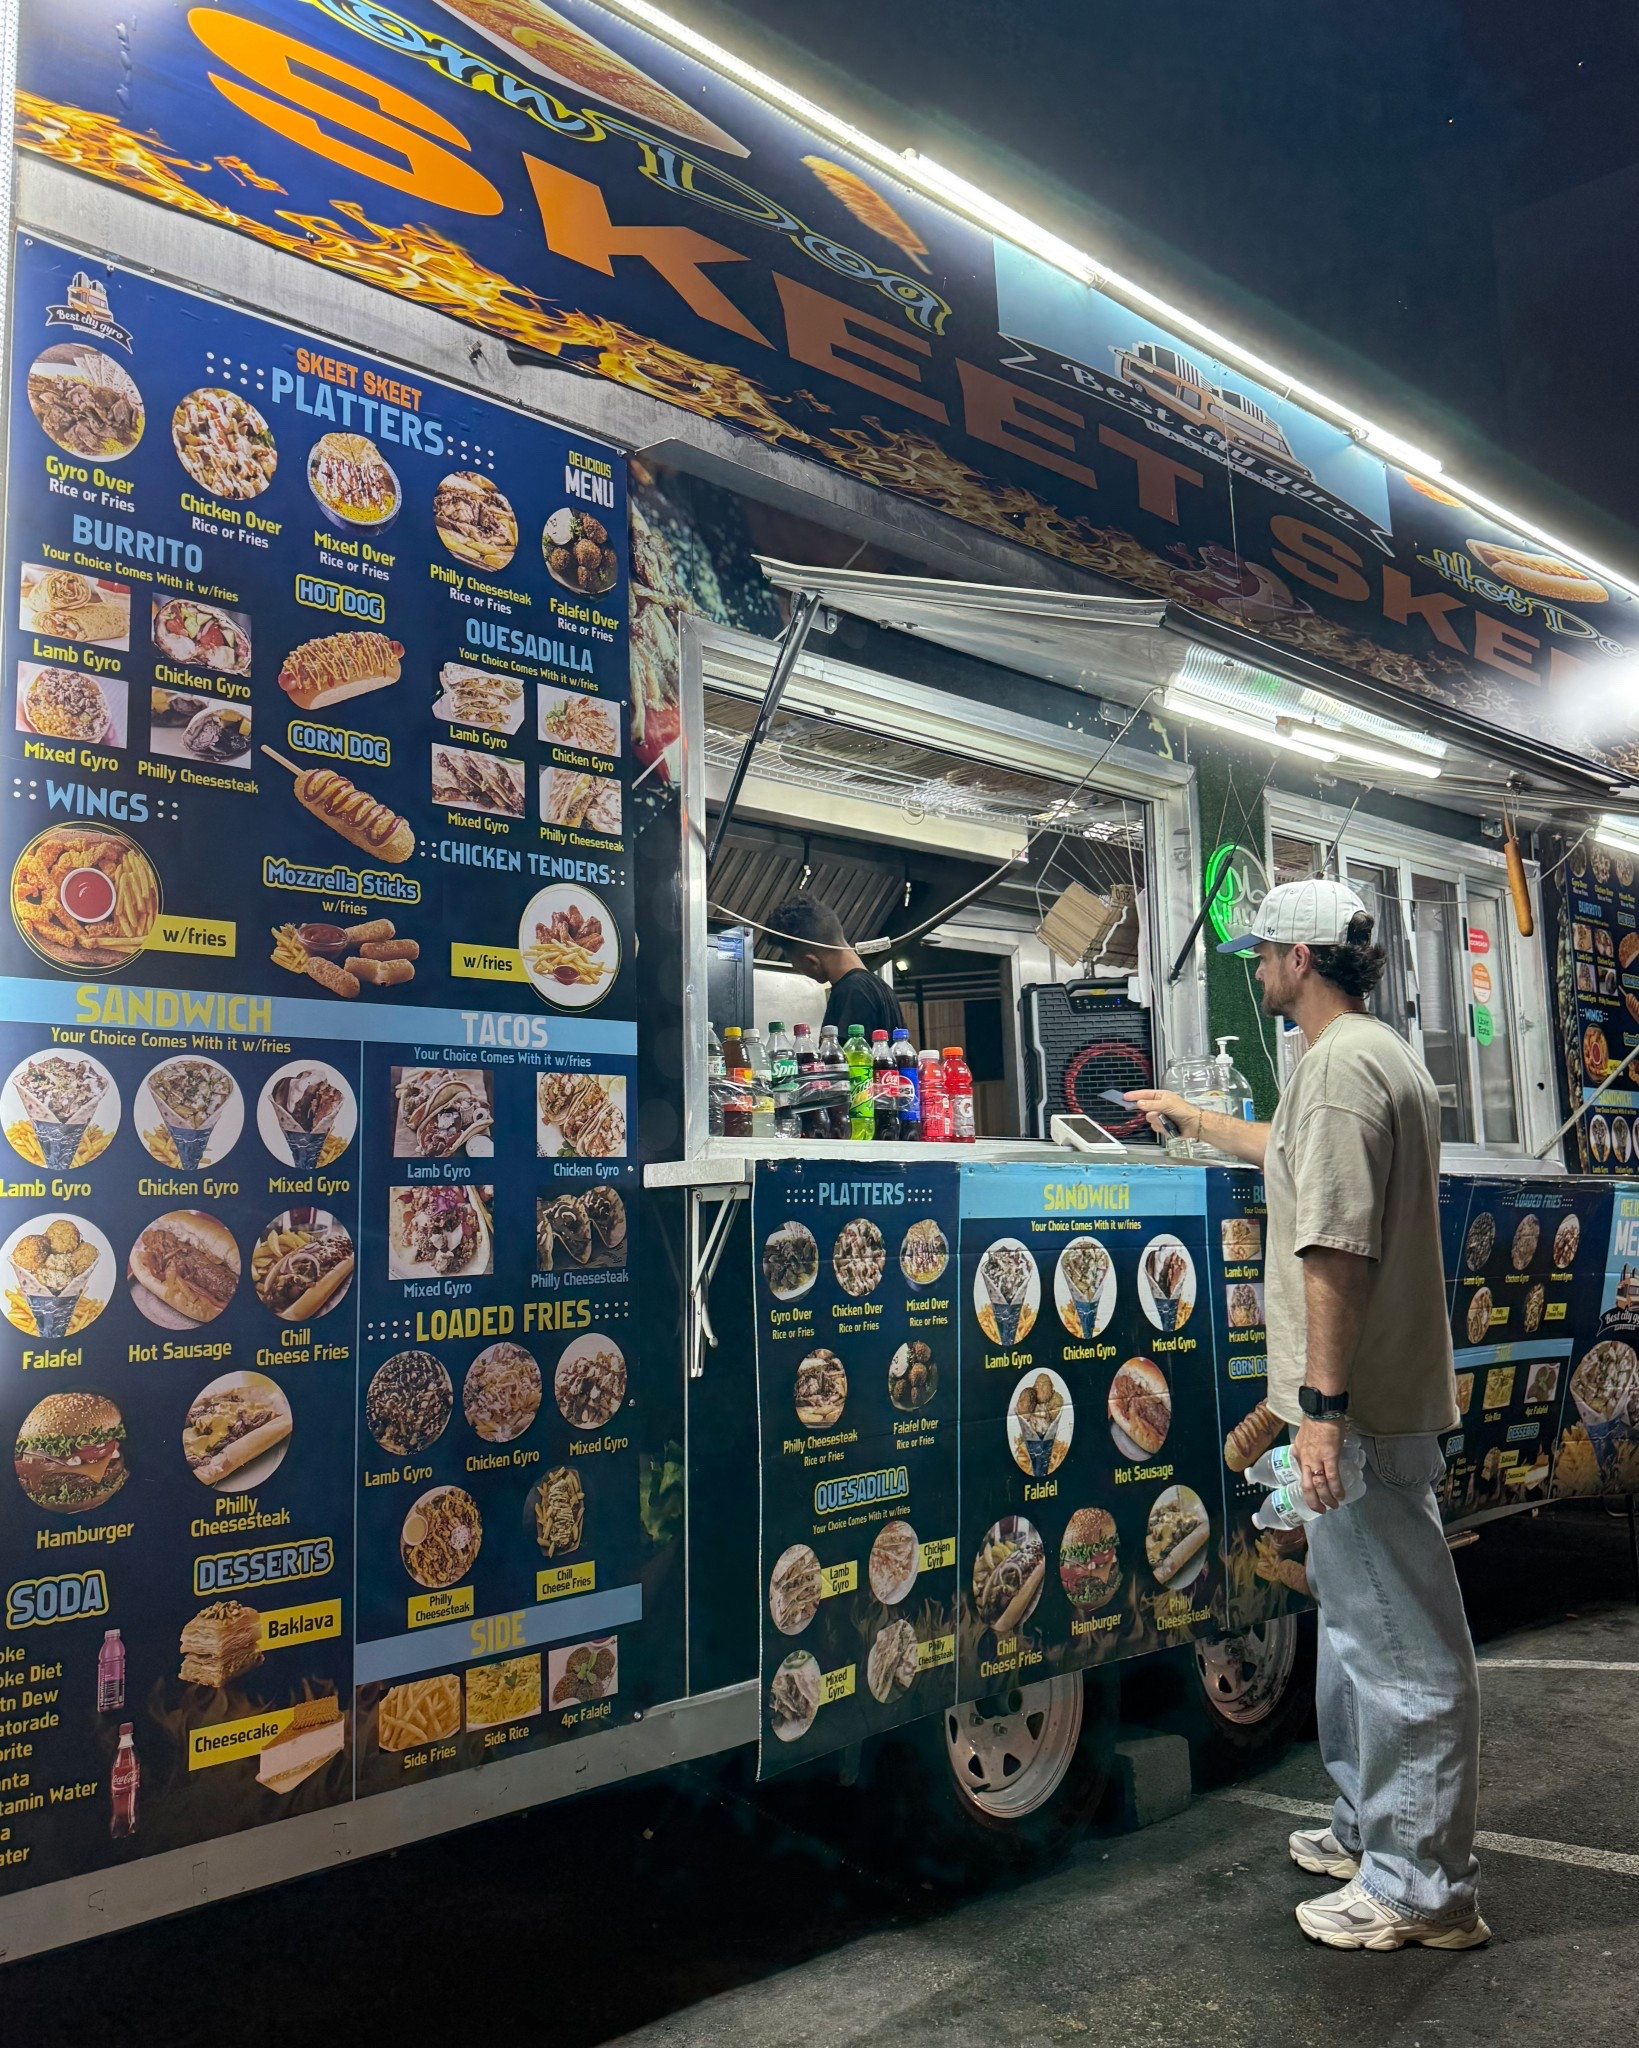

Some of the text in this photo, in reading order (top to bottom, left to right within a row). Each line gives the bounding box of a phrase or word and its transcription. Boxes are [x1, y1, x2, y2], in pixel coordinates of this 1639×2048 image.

[581, 108, 952, 336] Dog
[187, 8, 1203, 526] SKEET
[56, 309, 80, 322] Best
[81, 314, 98, 329] city
[100, 323, 124, 339] gyro
[297, 348, 422, 411] SKEET SKEET
[271, 367, 444, 456] PLATTERS
[1061, 363, 1359, 523] Best city gyro
[46, 455, 134, 494] Gyro Over
[568, 451, 612, 479] DELICIOUS
[49, 479, 135, 513] Rice or Fries
[565, 466, 614, 509] MENU
[180, 493, 282, 535] Chicken Over
[73, 513, 202, 573] BURRITO
[42, 543, 239, 603] Your Choice Comes With it w/fries
[429, 563, 532, 606] Philly Cheesesteak
[1417, 549, 1533, 617] Hot
[298, 576, 382, 620] HOT DOG
[466, 617, 594, 674] QUESADILLA
[155, 664, 251, 698] Chicken Gyro
[291, 725, 387, 762] CORN DOG
[552, 748, 615, 773] Chicken Gyro
[138, 760, 259, 794] Philly Cheesesteak
[46, 780, 149, 822] WINGS
[440, 840, 610, 885] CHICKEN TENDERS
[267, 861, 417, 900] Mozzrella Sticks
[1578, 901, 1602, 917] BURRITO
[162, 926, 227, 947] w/fries
[75, 985, 272, 1033] SANDWICH
[461, 1012, 549, 1048] TACOS
[413, 1047, 592, 1068] Your Choice Comes With it w/fries
[772, 1062, 798, 1077] Spri
[553, 1163, 620, 1179] Chicken Gyro
[0, 1178, 92, 1201] Lamb Gyro
[818, 1182, 905, 1206] PLATTERS
[1043, 1183, 1130, 1211] SANDWICH
[1514, 1193, 1563, 1208] LOADED FRIES
[1031, 1219, 1142, 1232] Your Choice Comes With it w/fries
[1614, 1219, 1639, 1257] ME
[1225, 1266, 1259, 1280] Lamb Gyro
[415, 1299, 592, 1342] LOADED FRIES
[770, 1309, 813, 1325] Gyro Over
[832, 1303, 884, 1318] Chicken Over
[1605, 1313, 1620, 1324] Best
[280, 1328, 311, 1347] Chill
[838, 1321, 880, 1334] Rice or Fries
[128, 1341, 233, 1363] Hot Sausage
[256, 1343, 350, 1367] Cheese Fries
[1152, 1337, 1197, 1353] Mixed Gyro
[22, 1348, 82, 1370] Falafel
[985, 1353, 1033, 1370] Lamb Gyro
[1231, 1358, 1268, 1376] CORN DO
[893, 1418, 939, 1435] Falafel Over
[569, 1436, 629, 1456] Mixed Gyro
[783, 1429, 858, 1455] Philly Cheesesteak
[1115, 1463, 1173, 1485] Hot Sausage
[816, 1467, 908, 1512] QUESADILLA
[1024, 1481, 1058, 1501] Falafel
[215, 1494, 258, 1517] Philly
[36, 1520, 135, 1549] Hamburger
[190, 1508, 291, 1538] Cheesesteak
[199, 1542, 330, 1591] DESSERTS
[829, 1567, 850, 1580] Lamb
[10, 1574, 105, 1625] SODA
[832, 1580, 850, 1594] Gyro
[1169, 1596, 1193, 1613] Philly
[268, 1612, 334, 1639] Baklava
[1071, 1613, 1122, 1636] Hamburger
[1157, 1606, 1211, 1632] Cheesesteak
[470, 1611, 526, 1657] SIDE
[928, 1640, 945, 1653] Philly
[997, 1637, 1017, 1656] Chill
[918, 1651, 954, 1666] Cheesesteak
[980, 1650, 1043, 1679] Cheese Fries
[30, 1662, 63, 1683] Diet
[22, 1689, 59, 1709] Dew
[561, 1702, 611, 1729] 4pc Falafel
[195, 1721, 279, 1753] Cheesecake
[484, 1725, 530, 1748] Side Rice
[403, 1746, 457, 1770] Side Fries
[49, 1781, 98, 1804] Water
